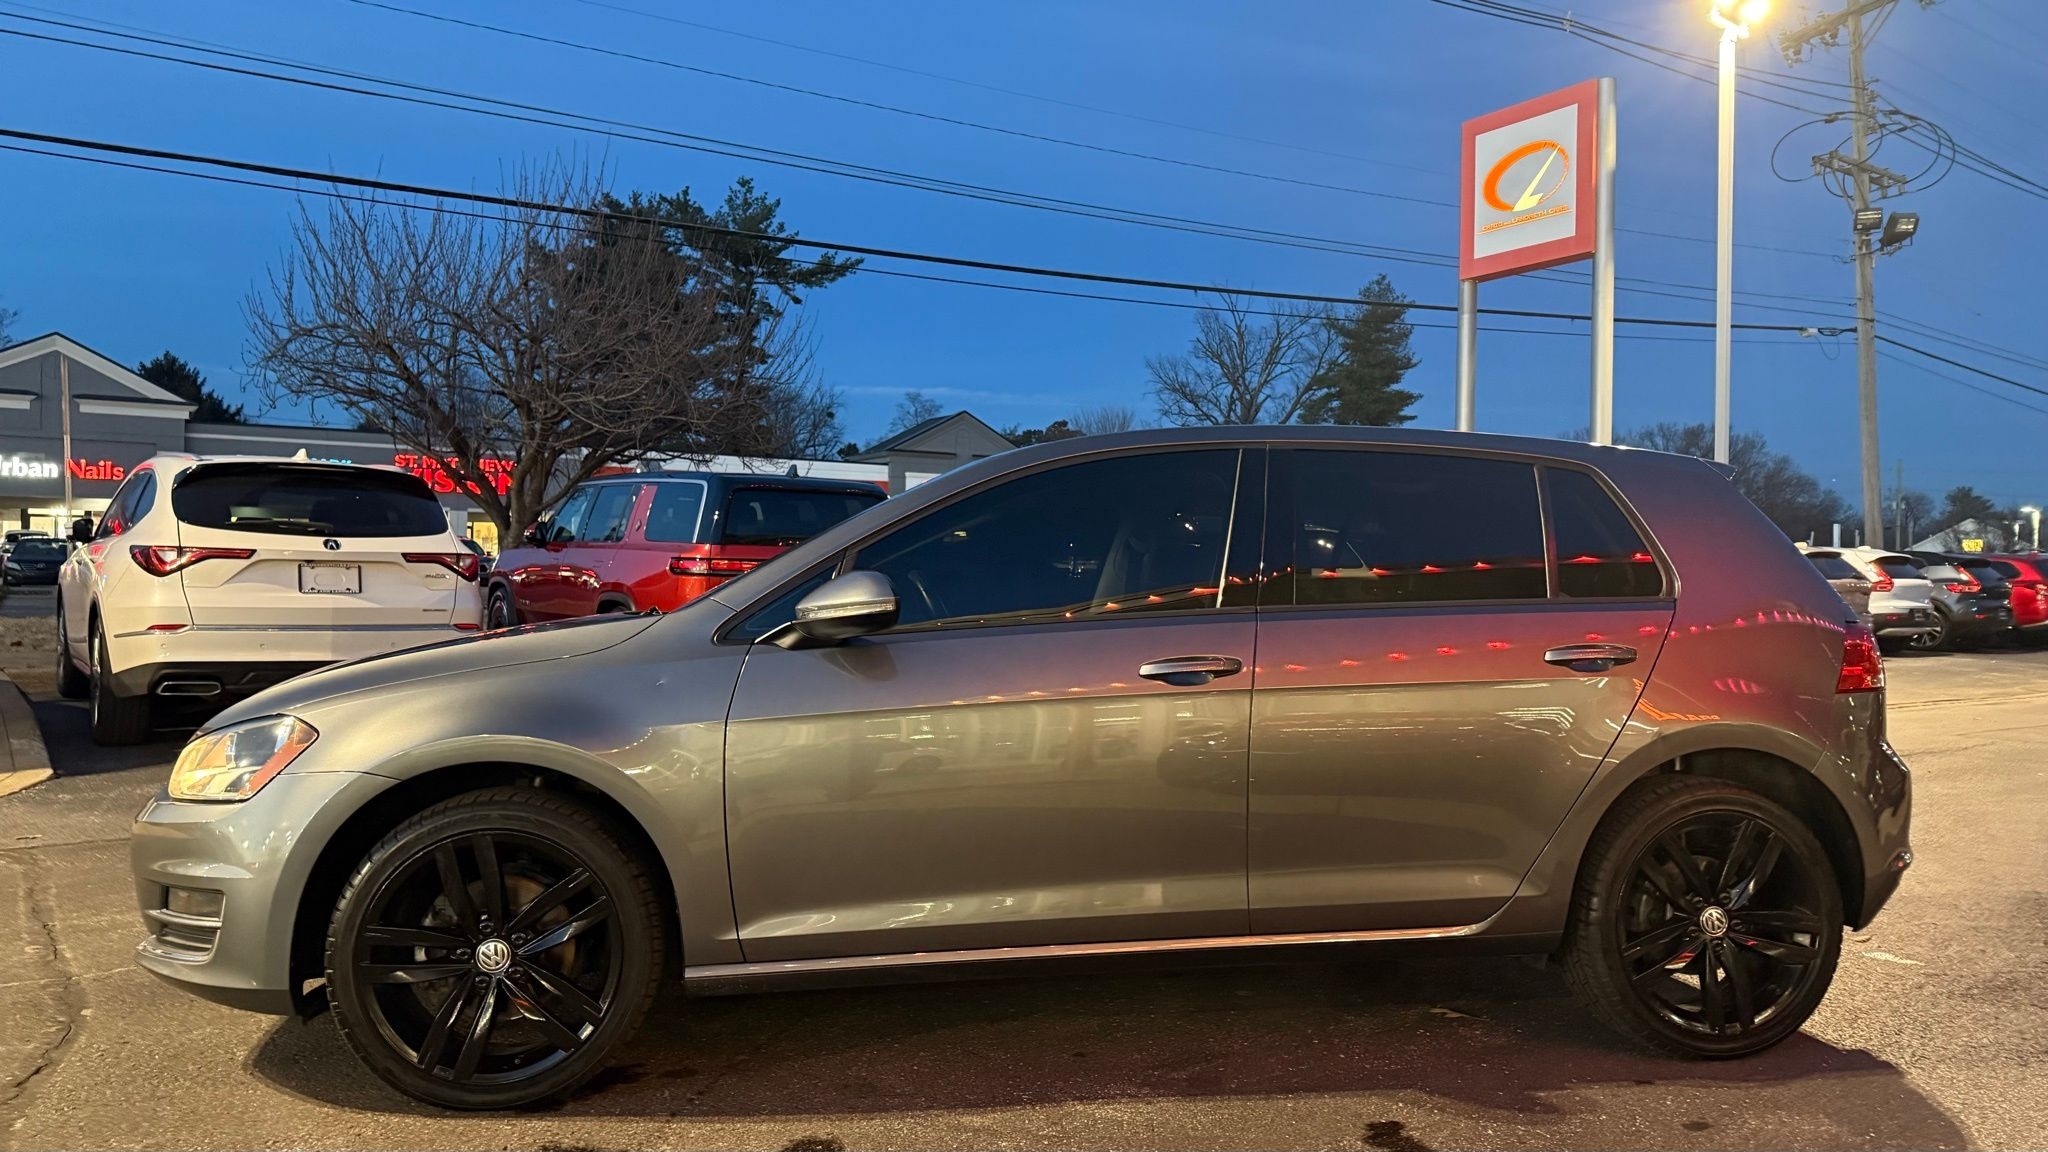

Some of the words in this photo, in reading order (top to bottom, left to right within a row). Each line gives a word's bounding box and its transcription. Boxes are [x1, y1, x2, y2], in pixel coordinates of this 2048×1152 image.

[0, 455, 58, 478] rban
[66, 459, 124, 480] Nails
[394, 454, 418, 468] ST.
